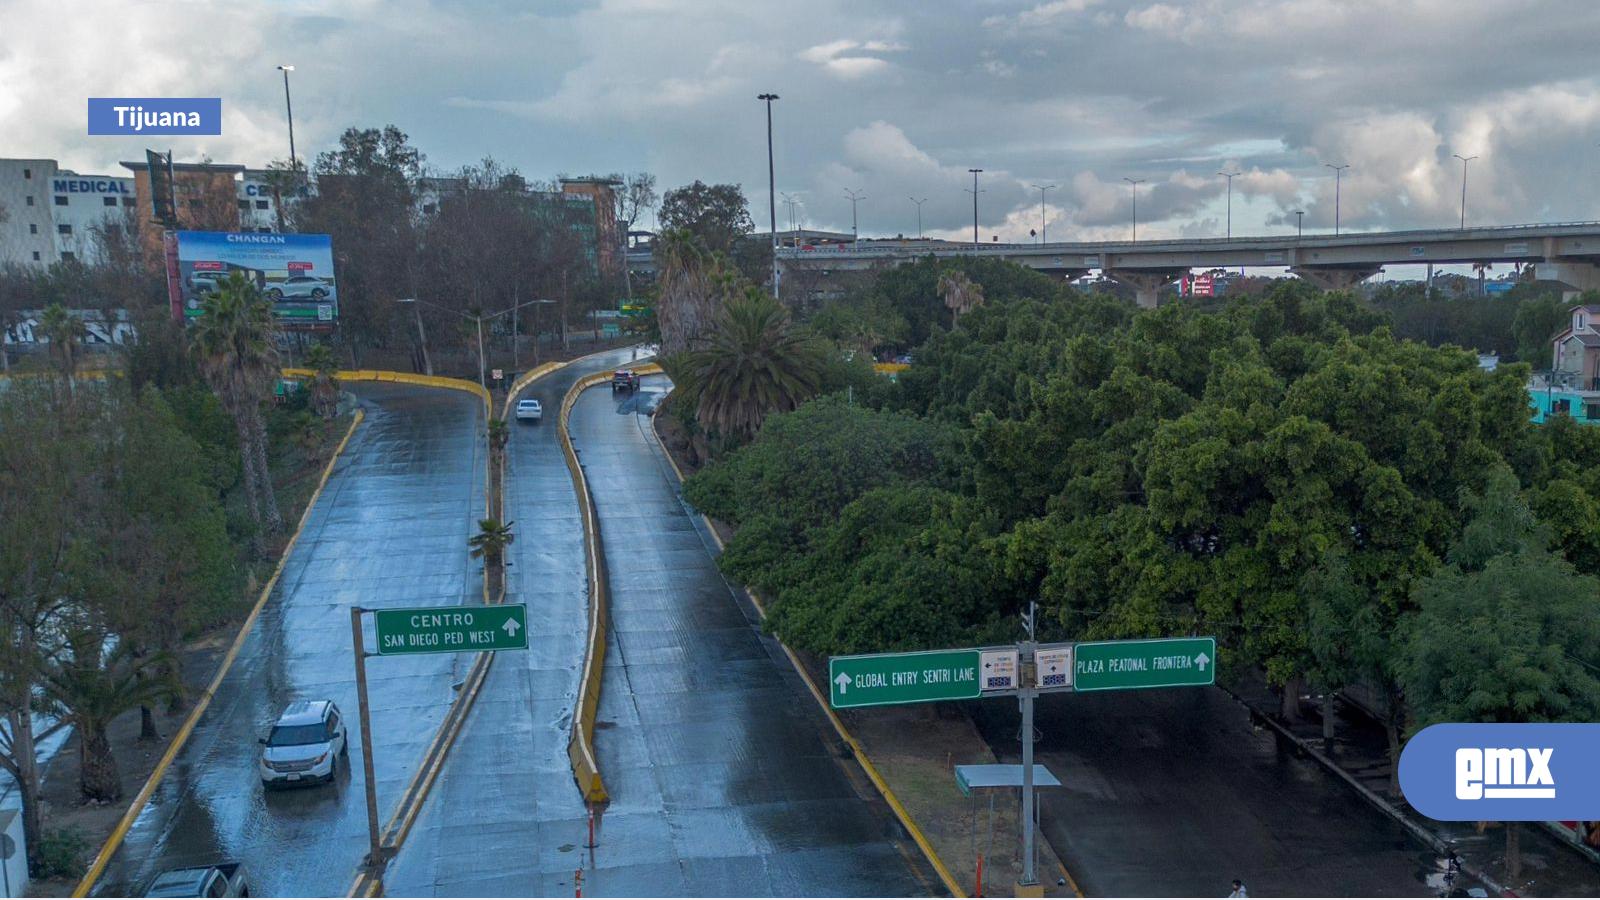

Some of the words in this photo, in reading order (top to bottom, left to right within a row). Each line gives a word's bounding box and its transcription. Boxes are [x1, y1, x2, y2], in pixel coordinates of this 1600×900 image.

[53, 179, 130, 195] MEDICAL
[226, 234, 286, 244] CHANGAN
[410, 613, 474, 628] CENTRO
[384, 634, 405, 648] SAN
[409, 632, 439, 647] DIEGO
[444, 631, 464, 645] PED
[469, 630, 496, 644] WEST
[1076, 659, 1104, 674] PLAZA
[1108, 657, 1148, 672] PEATONAL
[1152, 654, 1192, 670] FRONTERA
[854, 671, 887, 689] GLOBAL
[891, 669, 918, 686] ENTRY
[922, 667, 951, 684] SENTRI
[953, 666, 975, 683] LANE
